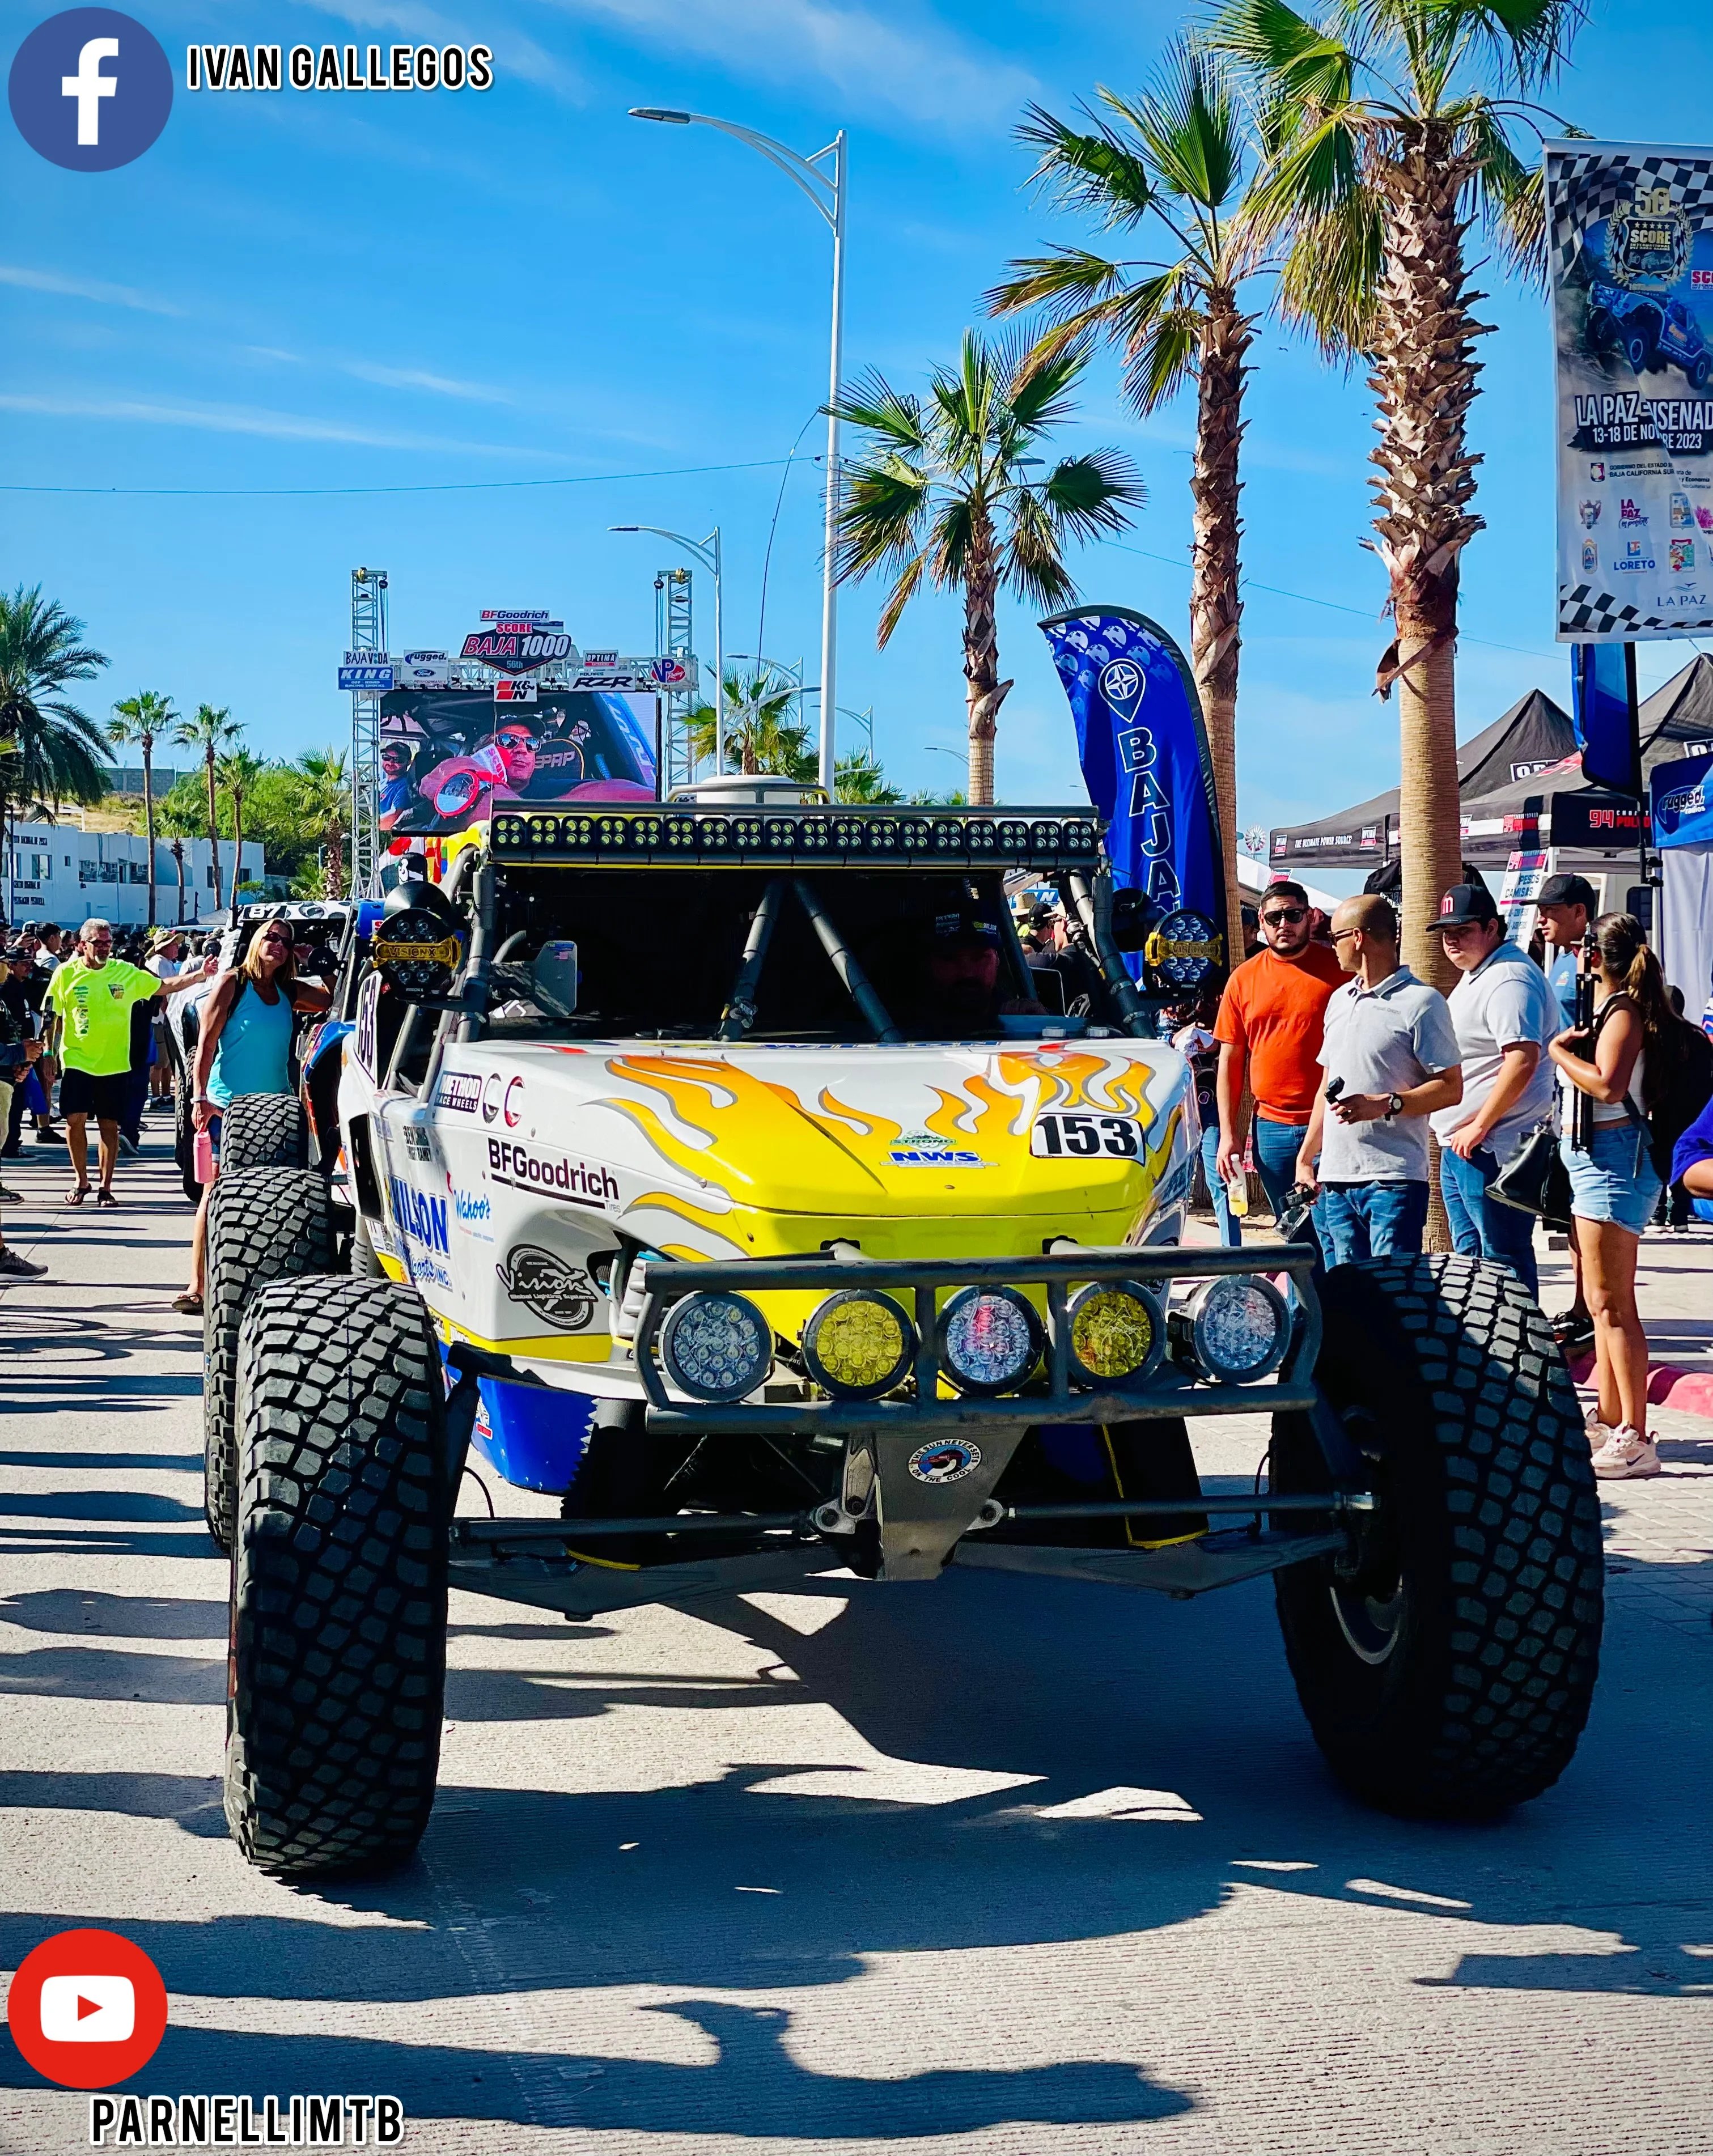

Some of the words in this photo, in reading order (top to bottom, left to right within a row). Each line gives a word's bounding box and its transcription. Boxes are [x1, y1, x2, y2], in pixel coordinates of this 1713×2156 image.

[1630, 229, 1671, 244] SCORE
[1692, 271, 1713, 283] SC
[1576, 397, 1598, 426] LA
[1603, 393, 1639, 425] PAZ
[1593, 426, 1621, 443] 13-18
[1624, 425, 1638, 442] DE
[1676, 433, 1702, 449] 2023
[1621, 499, 1635, 509] LA
[1621, 508, 1641, 518] PAZ
[1614, 560, 1656, 571] LORETO
[1657, 596, 1676, 606] LA
[1680, 595, 1707, 605] PAZ
[481, 610, 549, 619] BFGoodrich
[496, 623, 532, 633] SCORE
[462, 636, 516, 656] BAJA
[521, 635, 570, 657] 1000
[586, 653, 616, 662] OPTIMA
[506, 660, 523, 669] 56th
[341, 669, 392, 679] KING
[652, 659, 675, 684] VP
[573, 676, 634, 689] RZR
[512, 690, 528, 699] N
[1685, 805, 1706, 815] radios
[1117, 727, 1181, 915] BAJA
[1589, 809, 1614, 828] 94
[1617, 816, 1651, 827] POLO
[1302, 837, 1320, 847] ULTIMATE
[1320, 837, 1334, 846] POWER
[1505, 887, 1534, 898] CAMISAS
[249, 906, 282, 919] 87
[441, 1075, 481, 1100] METHOD
[436, 1094, 451, 1105] RACE
[452, 1097, 478, 1110] WHEELS
[1034, 1115, 1138, 1156] 153
[891, 1152, 980, 1162] NWS
[487, 1137, 619, 1200] BFGoodrich
[453, 1189, 491, 1220] Wahoo's
[604, 1199, 621, 1213] Tires
[388, 1173, 450, 1258] WILSON
[495, 1263, 584, 1291] Vision
[911, 1449, 924, 1464] THE
[923, 1441, 943, 1451] SUN
[944, 1440, 974, 1450] NEVER
[970, 1448, 980, 1463] SETS
[911, 1469, 923, 1478] ON
[946, 1467, 972, 1481] COOL
